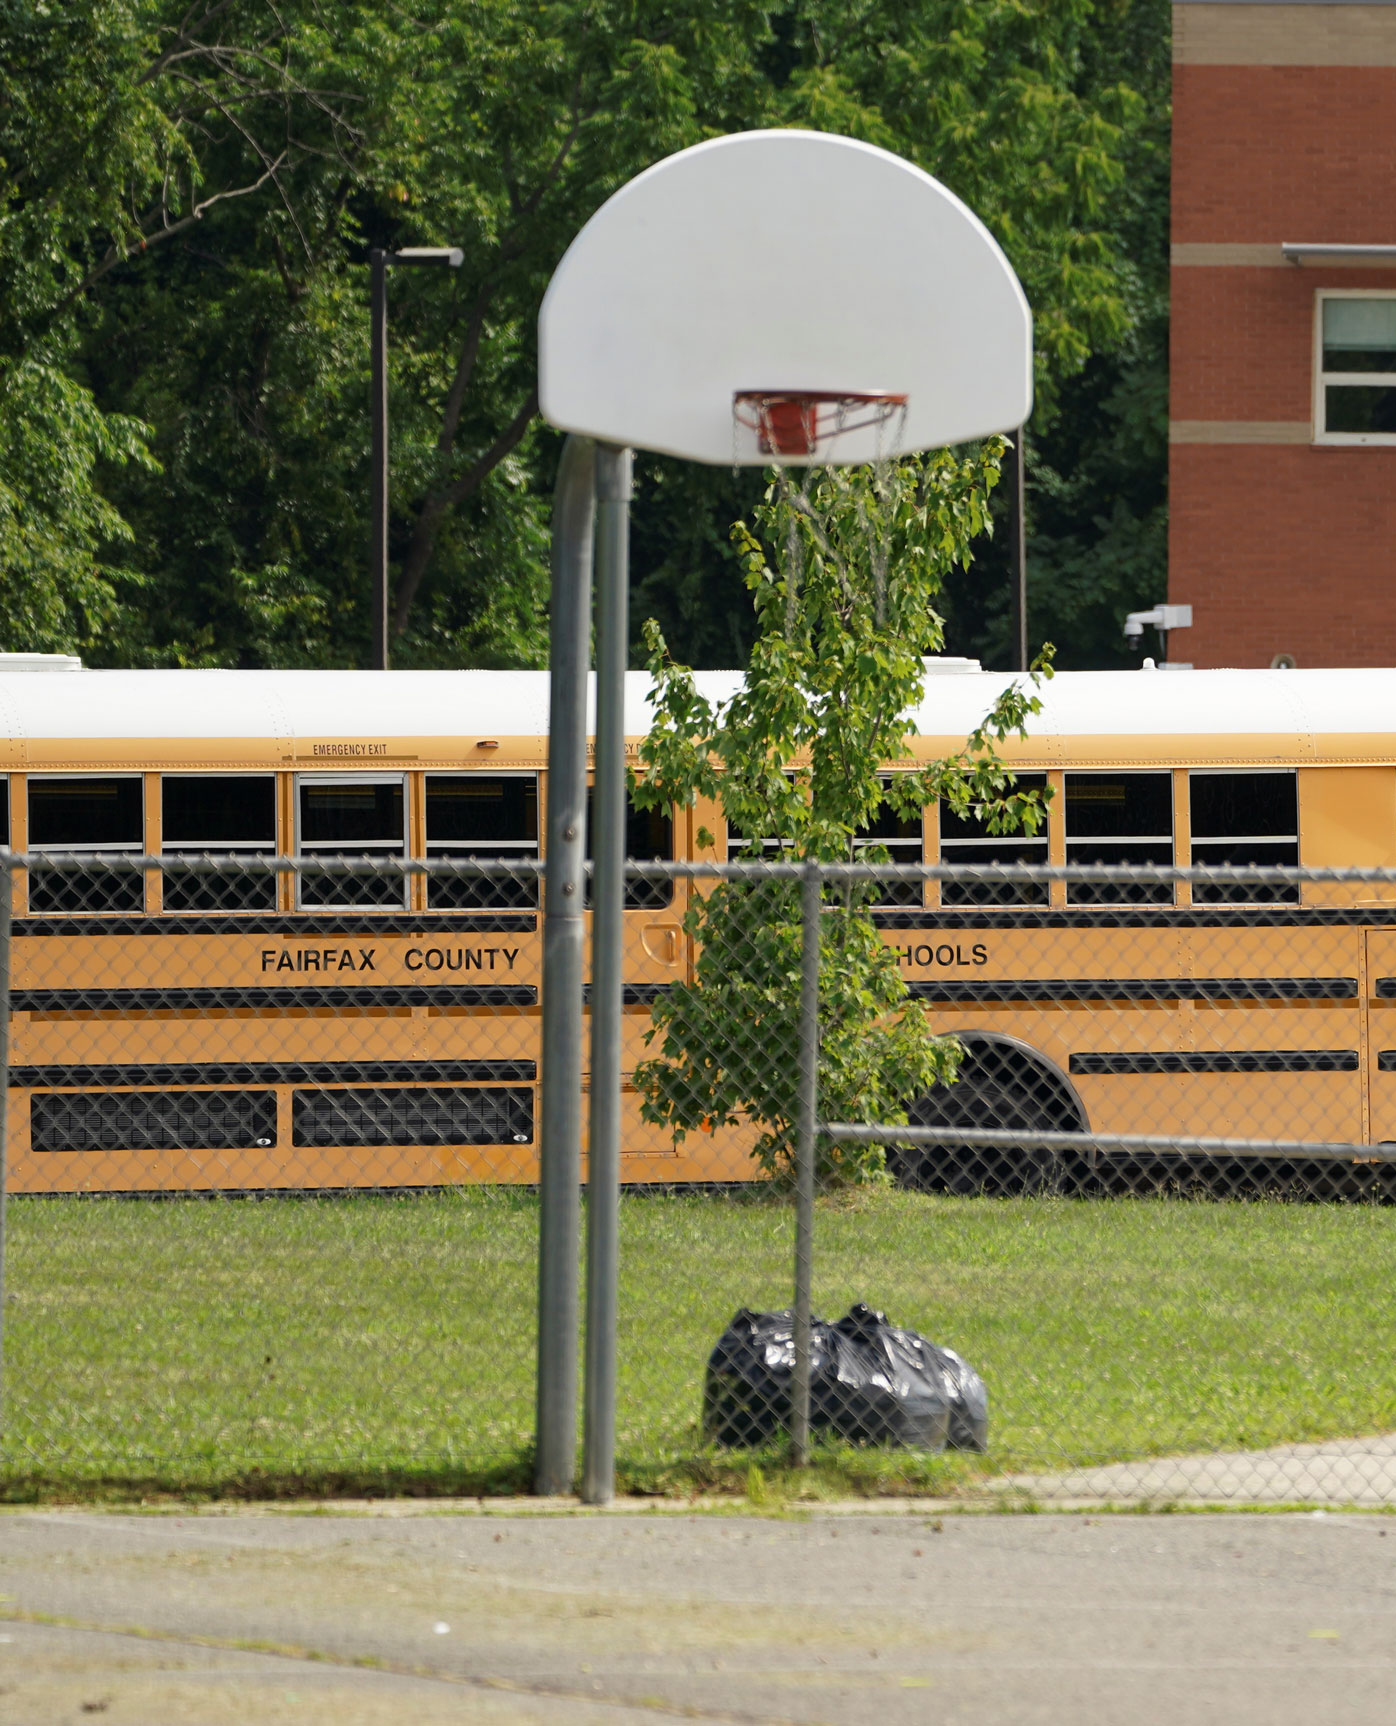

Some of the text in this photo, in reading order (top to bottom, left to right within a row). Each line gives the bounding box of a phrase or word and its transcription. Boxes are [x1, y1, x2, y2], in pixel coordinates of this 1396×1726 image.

[313, 744, 387, 755] EMERGENCY EXIT
[261, 943, 988, 972] FAIRFAX COUNTY HOOLS
